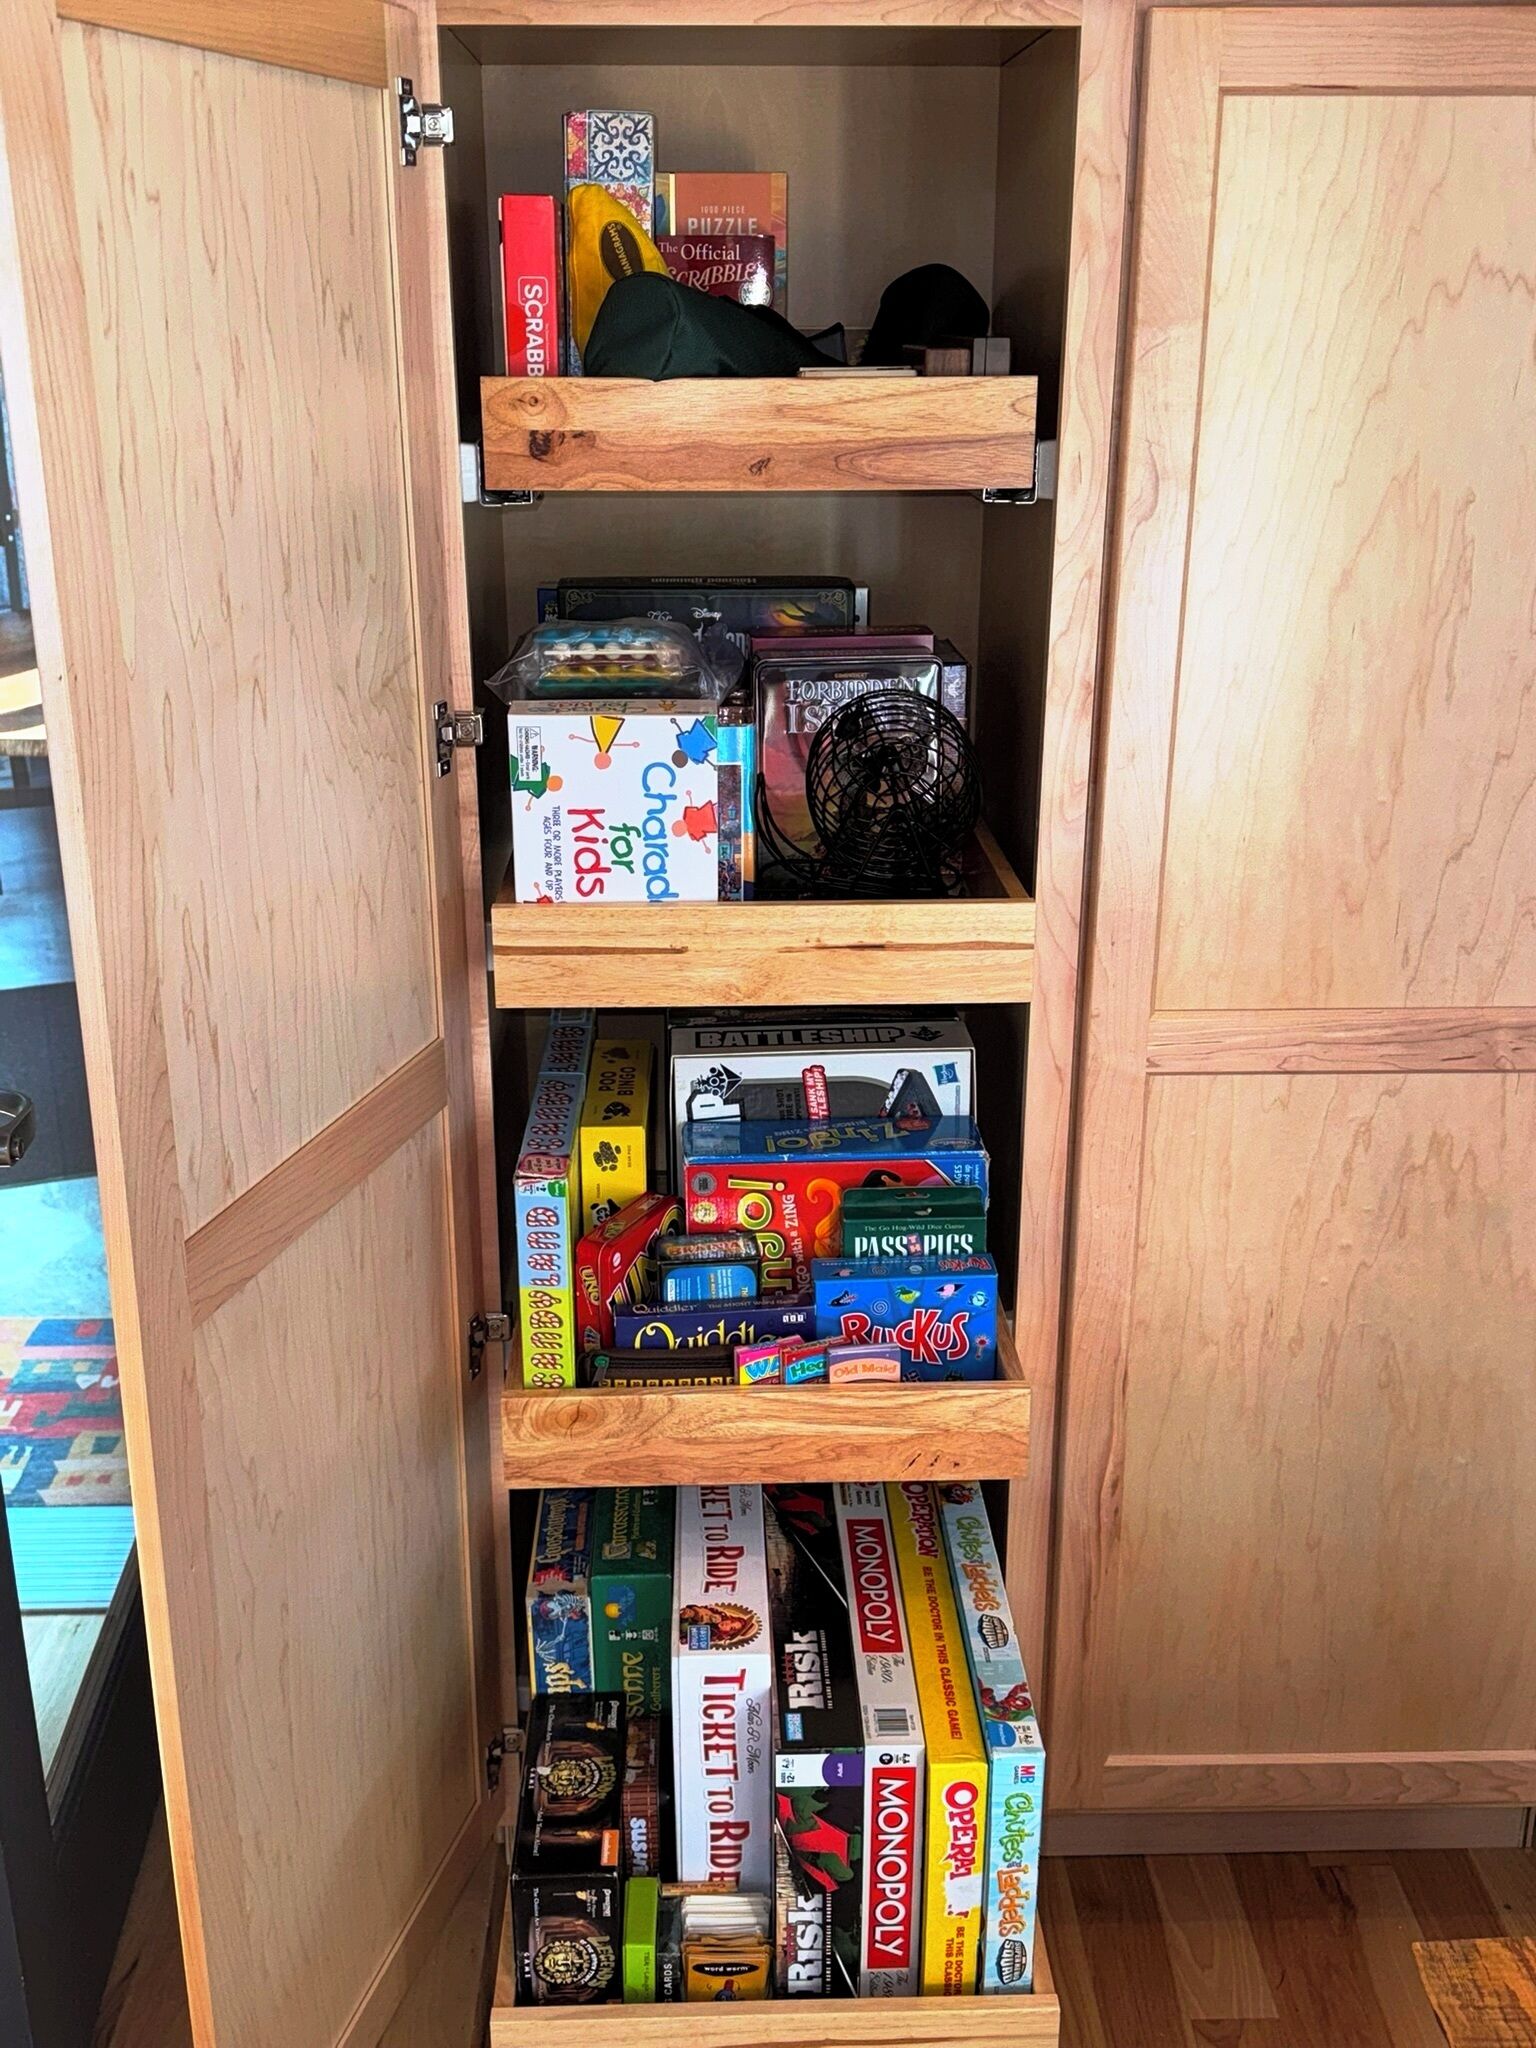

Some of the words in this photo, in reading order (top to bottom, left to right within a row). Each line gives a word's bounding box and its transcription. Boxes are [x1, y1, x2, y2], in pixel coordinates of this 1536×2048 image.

[722, 206, 745, 214] PIECE
[688, 218, 758, 235] PUZZLE
[658, 242, 678, 253] The
[681, 244, 740, 260] Official
[690, 607, 722, 621] Disney
[543, 816, 551, 834] AGES
[552, 805, 561, 827] THREE
[552, 831, 561, 841] OR
[642, 762, 679, 902] Charad
[544, 838, 552, 858] FOUR
[553, 845, 562, 867] MORE
[567, 808, 612, 897] Kids
[609, 823, 642, 874] for
[545, 862, 553, 877] AND
[546, 880, 553, 890] UP
[554, 870, 563, 900] PLAYERS
[547, 1026, 585, 1072] LAND
[699, 1026, 902, 1048] BATTLESHIP
[598, 1071, 616, 1092] POO
[618, 1066, 636, 1096] BINGO
[806, 1072, 814, 1085] MY
[808, 1088, 818, 1113] SANK
[527, 1080, 575, 1151] CANDY
[764, 1120, 909, 1153] Zingo!
[954, 1165, 962, 1184] AGES
[782, 1194, 798, 1229] ZING
[525, 1207, 562, 1287] LAND
[791, 1238, 804, 1262] with
[854, 1236, 908, 1258] PASS
[923, 1234, 973, 1255] PIGS
[580, 1265, 600, 1305] UNO
[632, 1304, 696, 1315] Quiddler
[527, 1290, 565, 1388] CANDY
[834, 1365, 858, 1378] Old
[861, 1363, 897, 1376] Maid
[705, 1524, 728, 1540] TO
[901, 1483, 939, 1559] OPERATION
[956, 1516, 990, 1560] Chutes
[703, 1546, 745, 1593] RIDE
[923, 1566, 933, 1577] BE
[853, 1525, 896, 1644] MONOPOLY
[924, 1579, 936, 1594] THE
[961, 1561, 1002, 1612] Ladders
[927, 1596, 942, 1631] DOCTOR
[934, 1632, 946, 1641] IN
[982, 1616, 997, 1647] SQUAD
[935, 1644, 949, 1665] THIS
[941, 1667, 956, 1707] CLASSIC
[702, 1668, 746, 1781] TICKET
[746, 1698, 762, 1726] Alan
[947, 1710, 963, 1740] GAME!
[746, 1727, 761, 1742] R.
[746, 1744, 760, 1774] Moon
[588, 1756, 618, 1799] LEGENDS
[1020, 1765, 1035, 1784] MB
[707, 1786, 734, 1813] TO
[998, 1792, 1034, 1863] Chutes
[708, 1821, 750, 1889] RIDE
[874, 1778, 911, 1956] MONOPOLY
[997, 1864, 1030, 1937] Ladders
[788, 1893, 823, 1993] RISK
[956, 1926, 965, 1938] BE
[587, 1935, 615, 1988] LEGENDS
[945, 1938, 954, 1958] THIS
[955, 1941, 964, 1958] THE
[1000, 1941, 1014, 1983] SQUAD
[664, 1963, 672, 1995] CARDS
